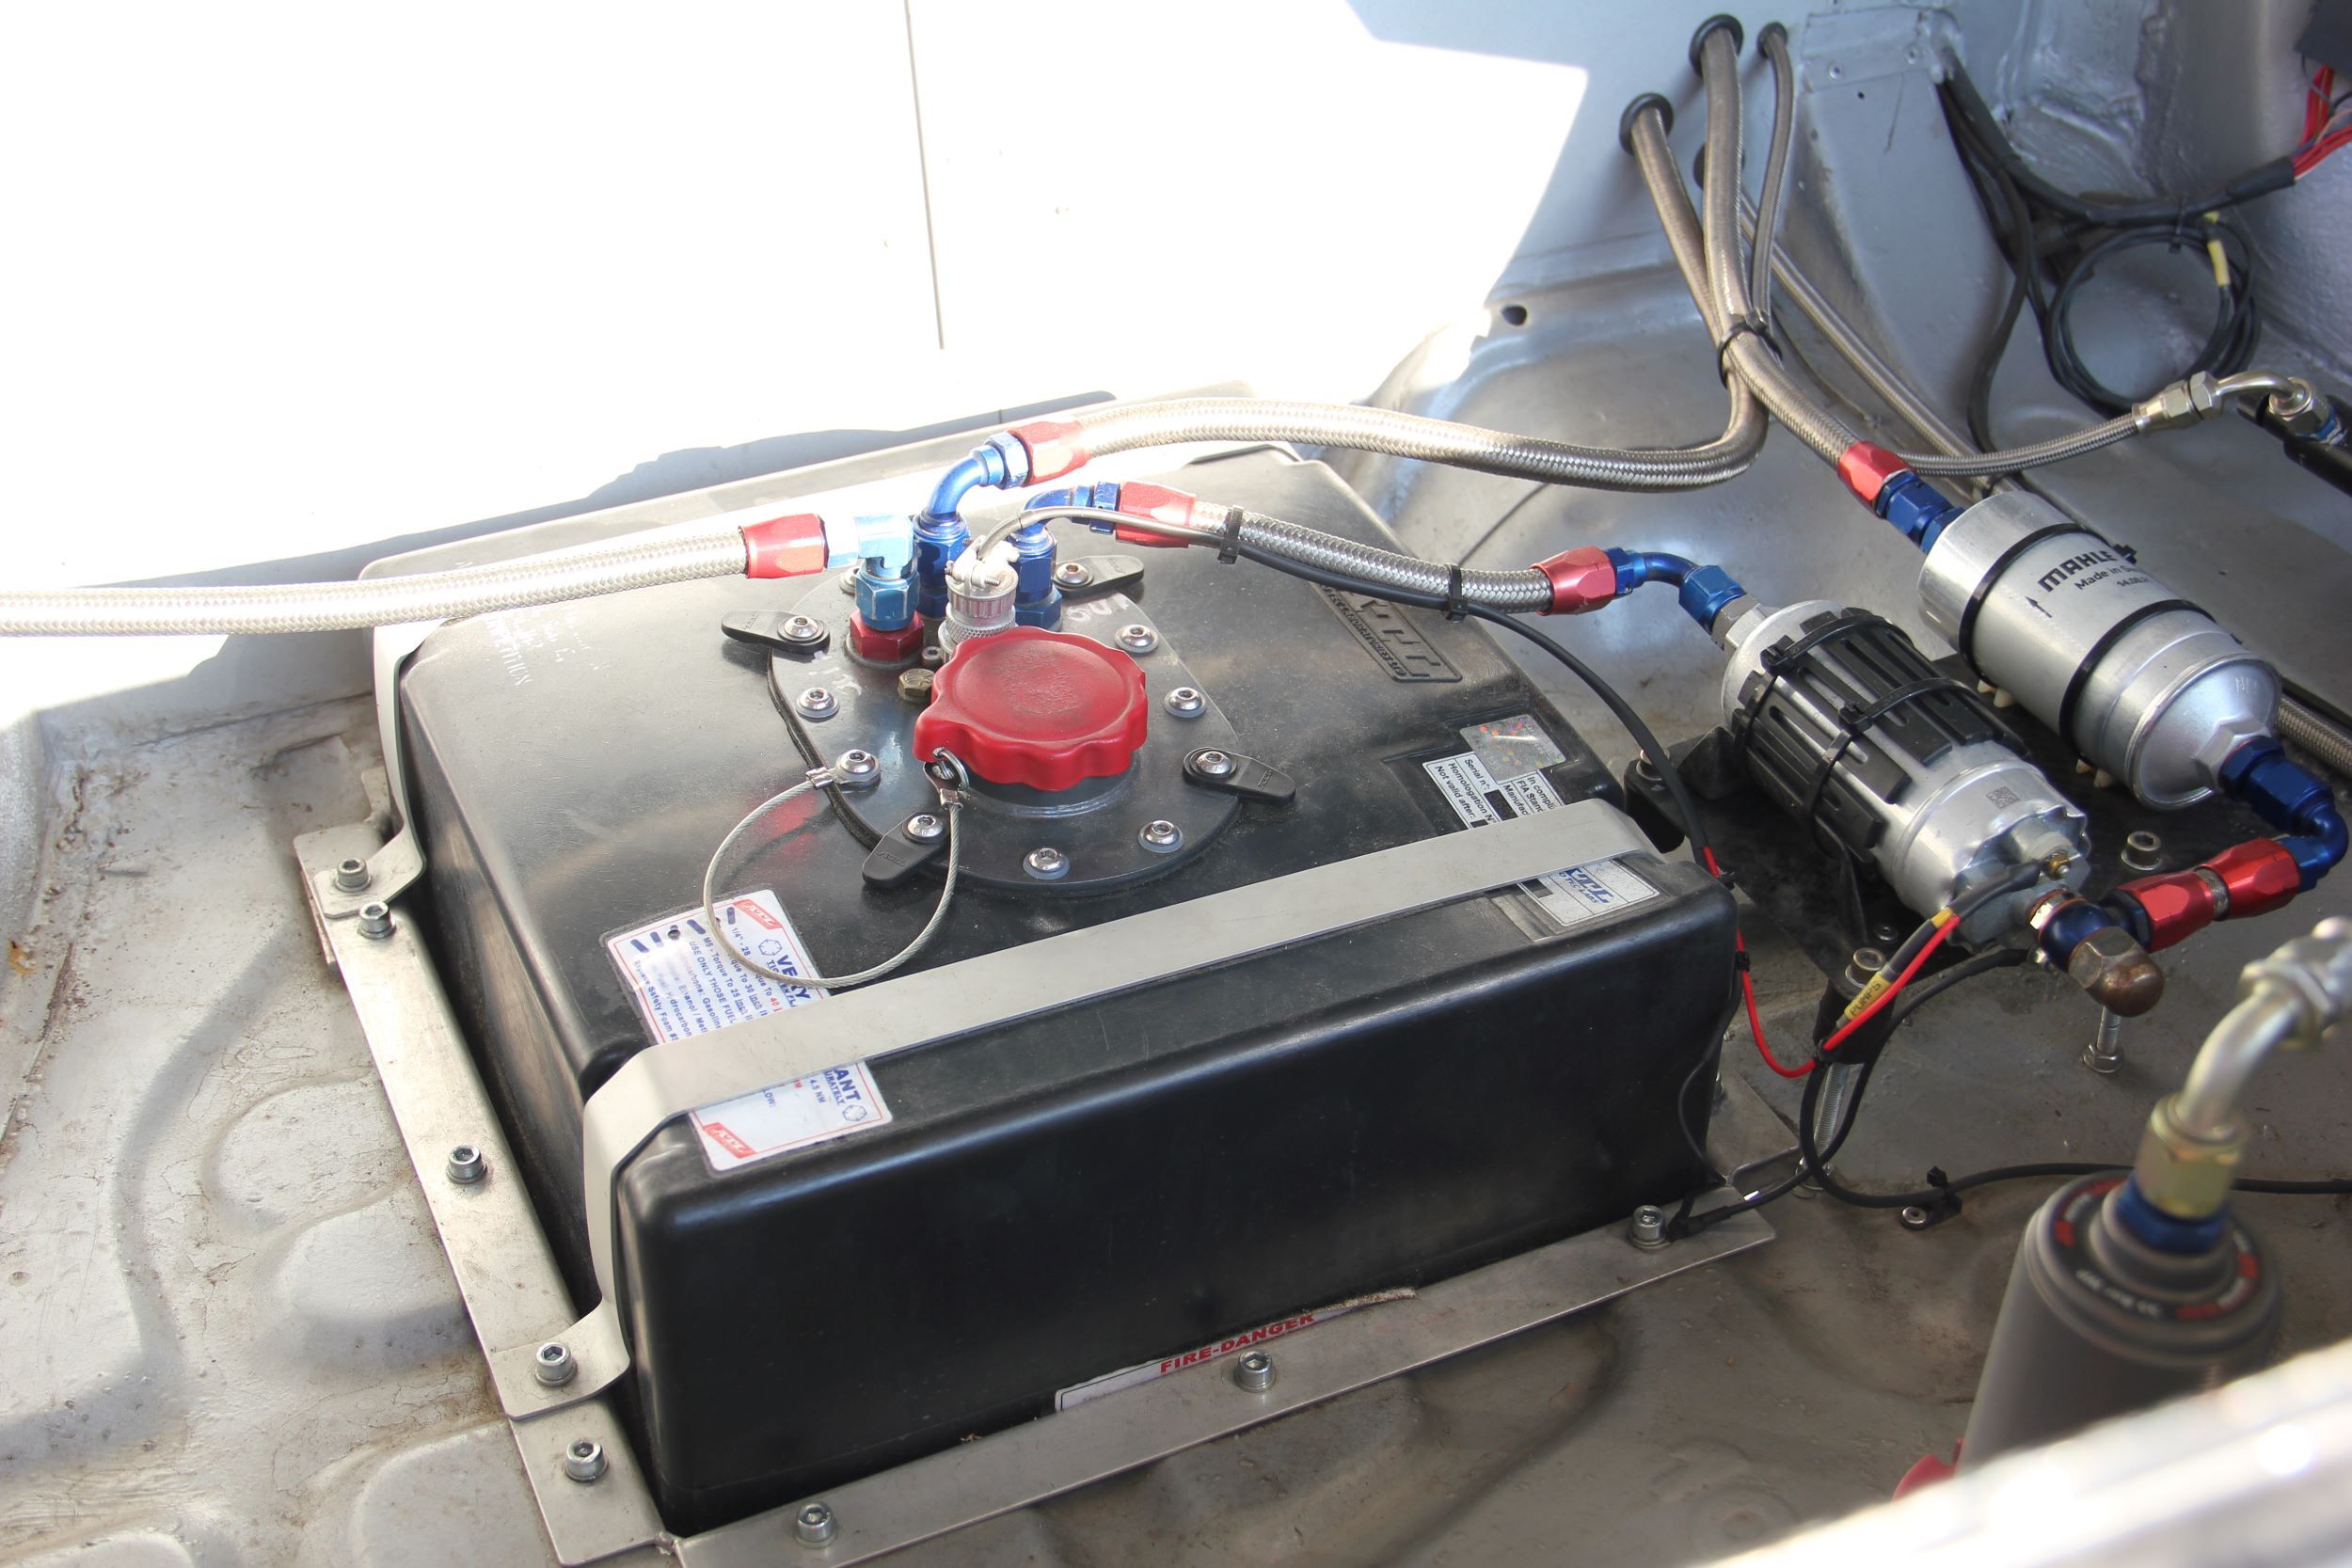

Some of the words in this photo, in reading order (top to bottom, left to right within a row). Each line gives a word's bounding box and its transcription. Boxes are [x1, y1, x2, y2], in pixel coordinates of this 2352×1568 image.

[2037, 550, 2118, 593] MAHLE
[2074, 570, 2109, 591] Made
[1435, 765, 1450, 780] Not
[1446, 780, 1463, 799] valid
[1448, 762, 1487, 815] Homologation
[1464, 758, 1485, 780] Serial
[1517, 780, 1530, 793] FIA
[689, 941, 702, 956] USE
[697, 956, 713, 977] ONLY
[708, 977, 727, 1004] THOSE
[711, 952, 729, 977] Torque
[724, 977, 734, 988] To
[730, 989, 741, 998] 25
[739, 974, 748, 984] To
[744, 984, 755, 995] 30
[647, 986, 664, 1012] Safety
[660, 1011, 674, 1033] Foam
[666, 990, 693, 1037] Hdrocarbon
[1849, 980, 1883, 1017] PUMPS
[741, 946, 752, 957] 28
[764, 987, 773, 997] To
[771, 997, 781, 1008] 40
[816, 1090, 827, 1104] NM
[1160, 1313, 1315, 1374] FIRE-DANGER
